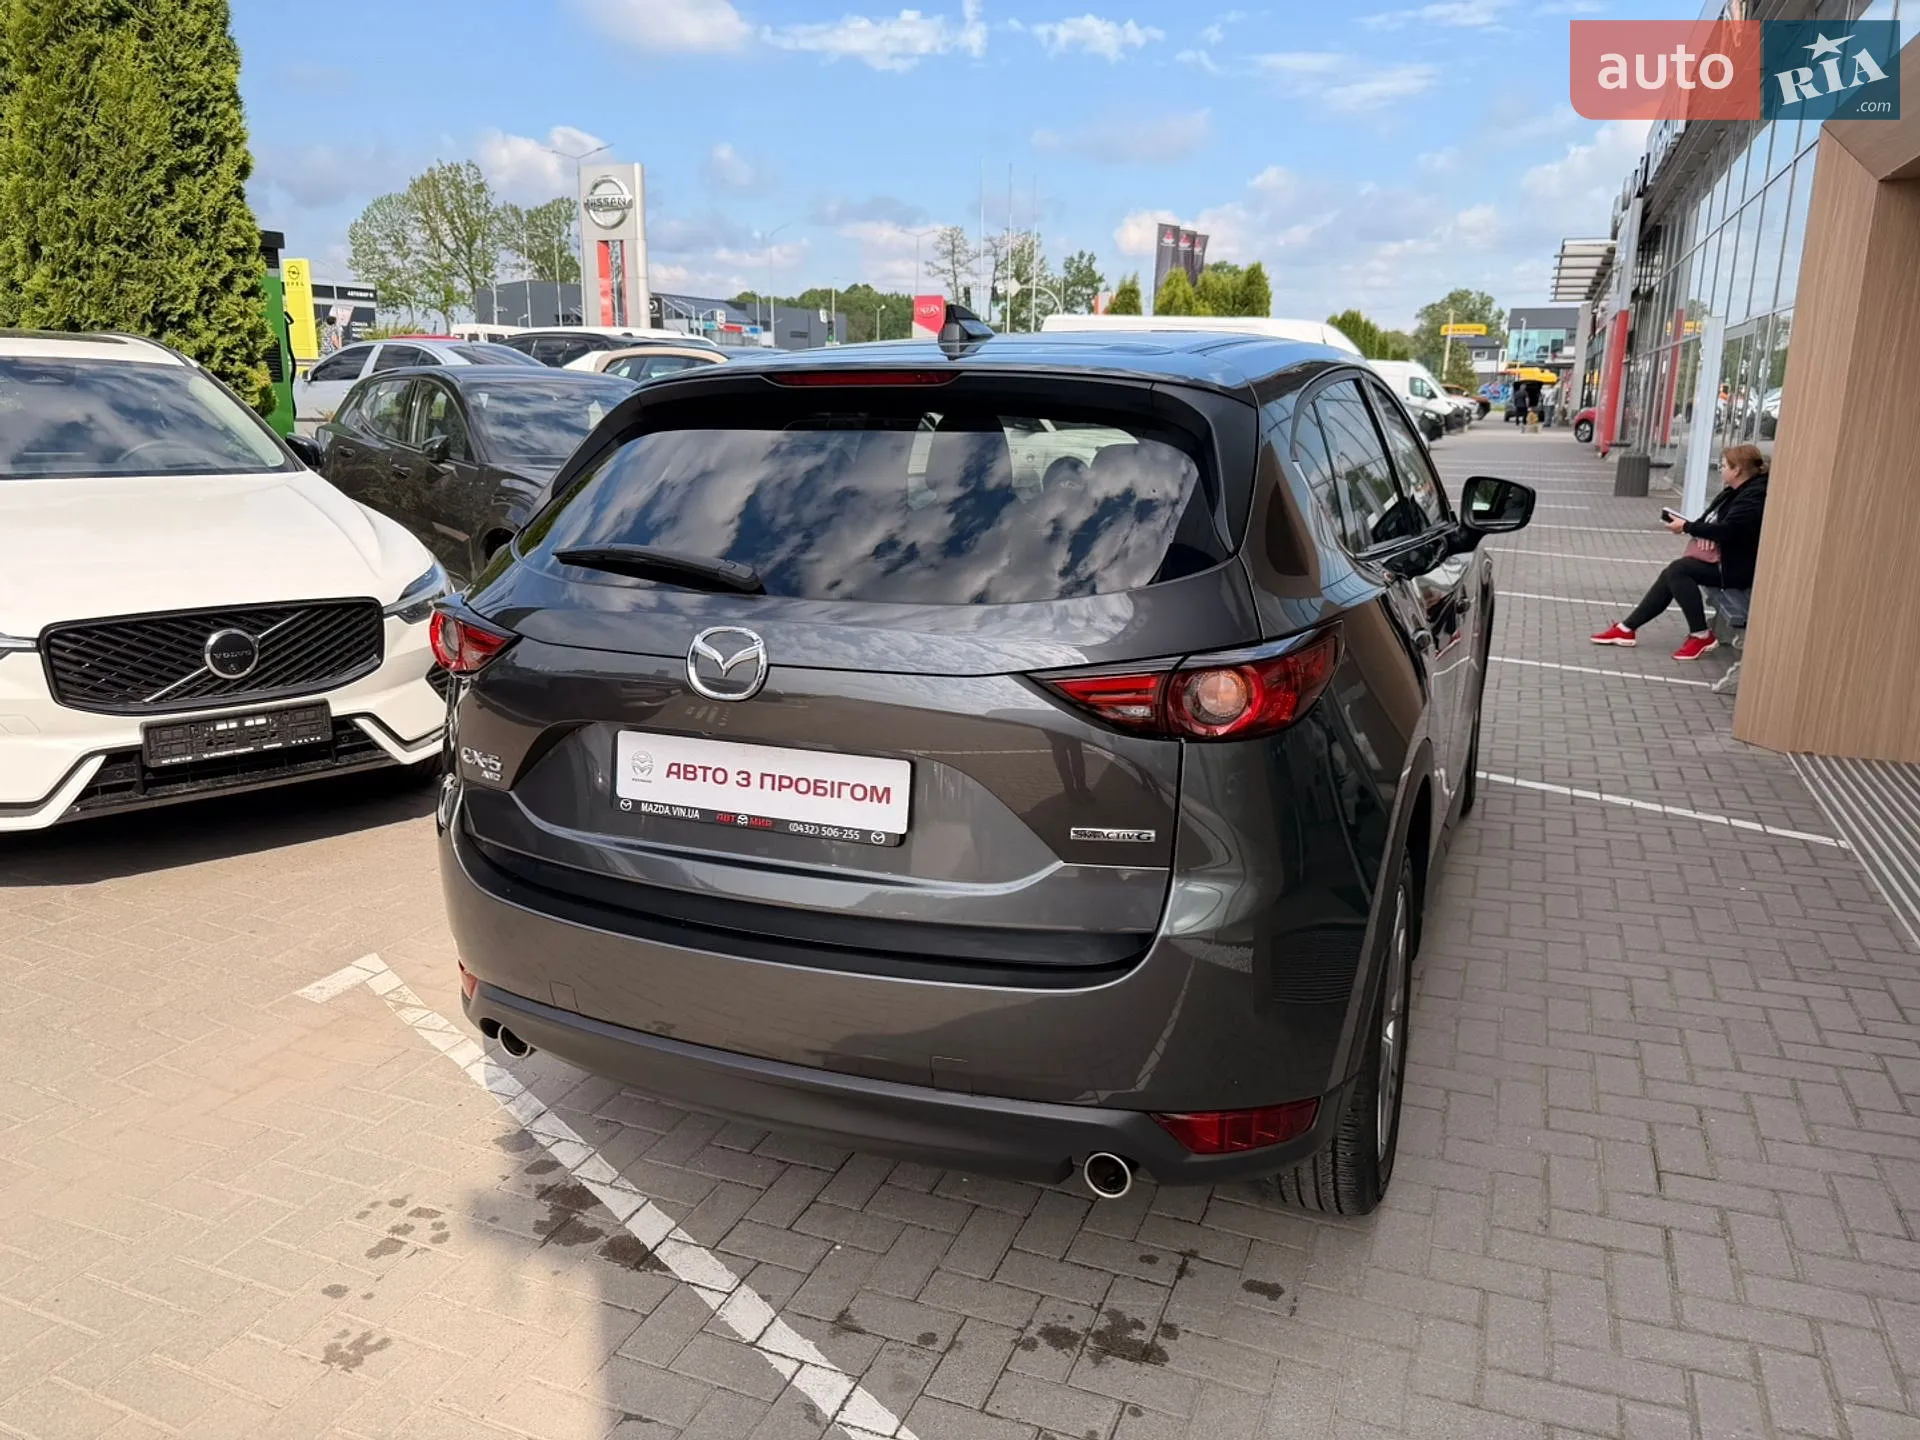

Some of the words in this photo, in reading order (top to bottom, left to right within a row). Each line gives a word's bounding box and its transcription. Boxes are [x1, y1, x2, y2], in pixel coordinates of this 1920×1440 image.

[584, 197, 628, 209] NISSAN
[665, 761, 729, 786] АВТО
[759, 772, 892, 805] ПРОБІГОМ
[640, 802, 701, 820] MAZDA.VIN.UA
[789, 821, 820, 836] (0432)
[821, 826, 861, 841] 506-255
